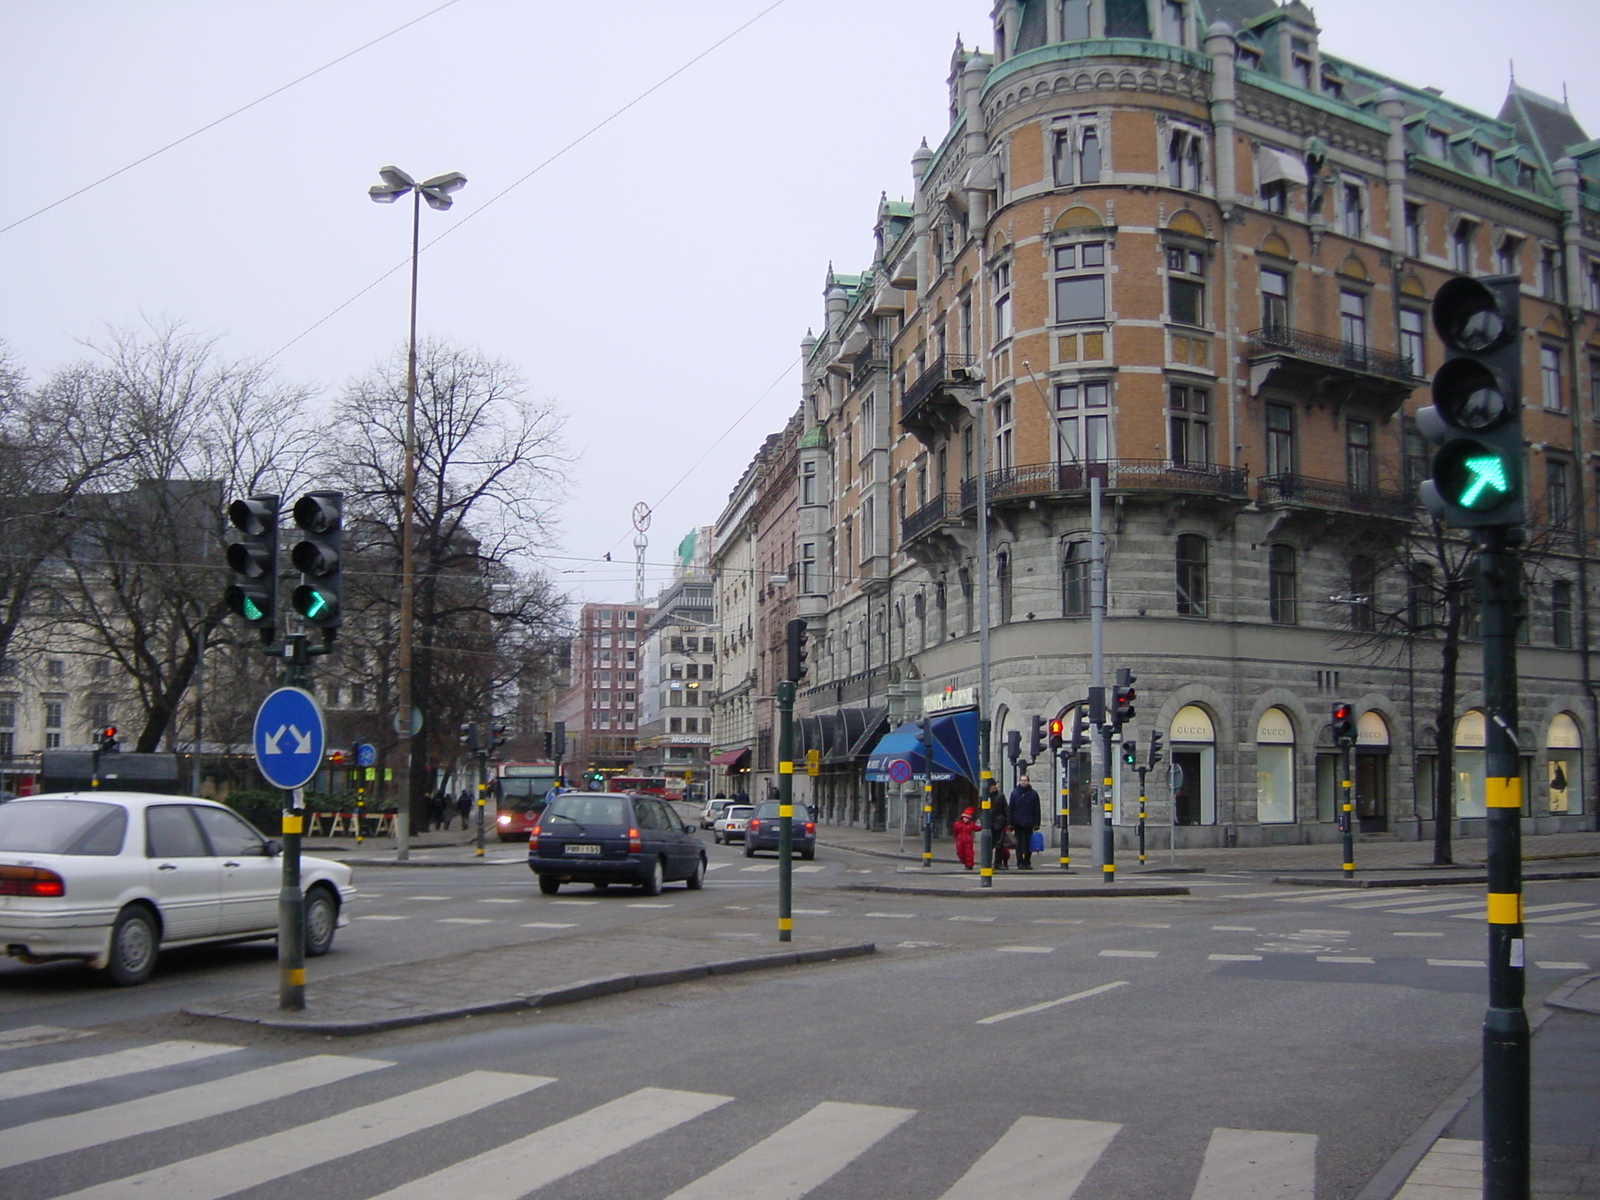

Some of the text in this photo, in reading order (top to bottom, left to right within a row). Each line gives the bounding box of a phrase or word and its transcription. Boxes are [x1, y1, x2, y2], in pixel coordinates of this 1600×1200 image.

[1261, 728, 1286, 736] GUCCI
[1359, 731, 1381, 739] GUCCI
[1463, 733, 1484, 741] GUCCI
[1553, 735, 1571, 743] GUCCI
